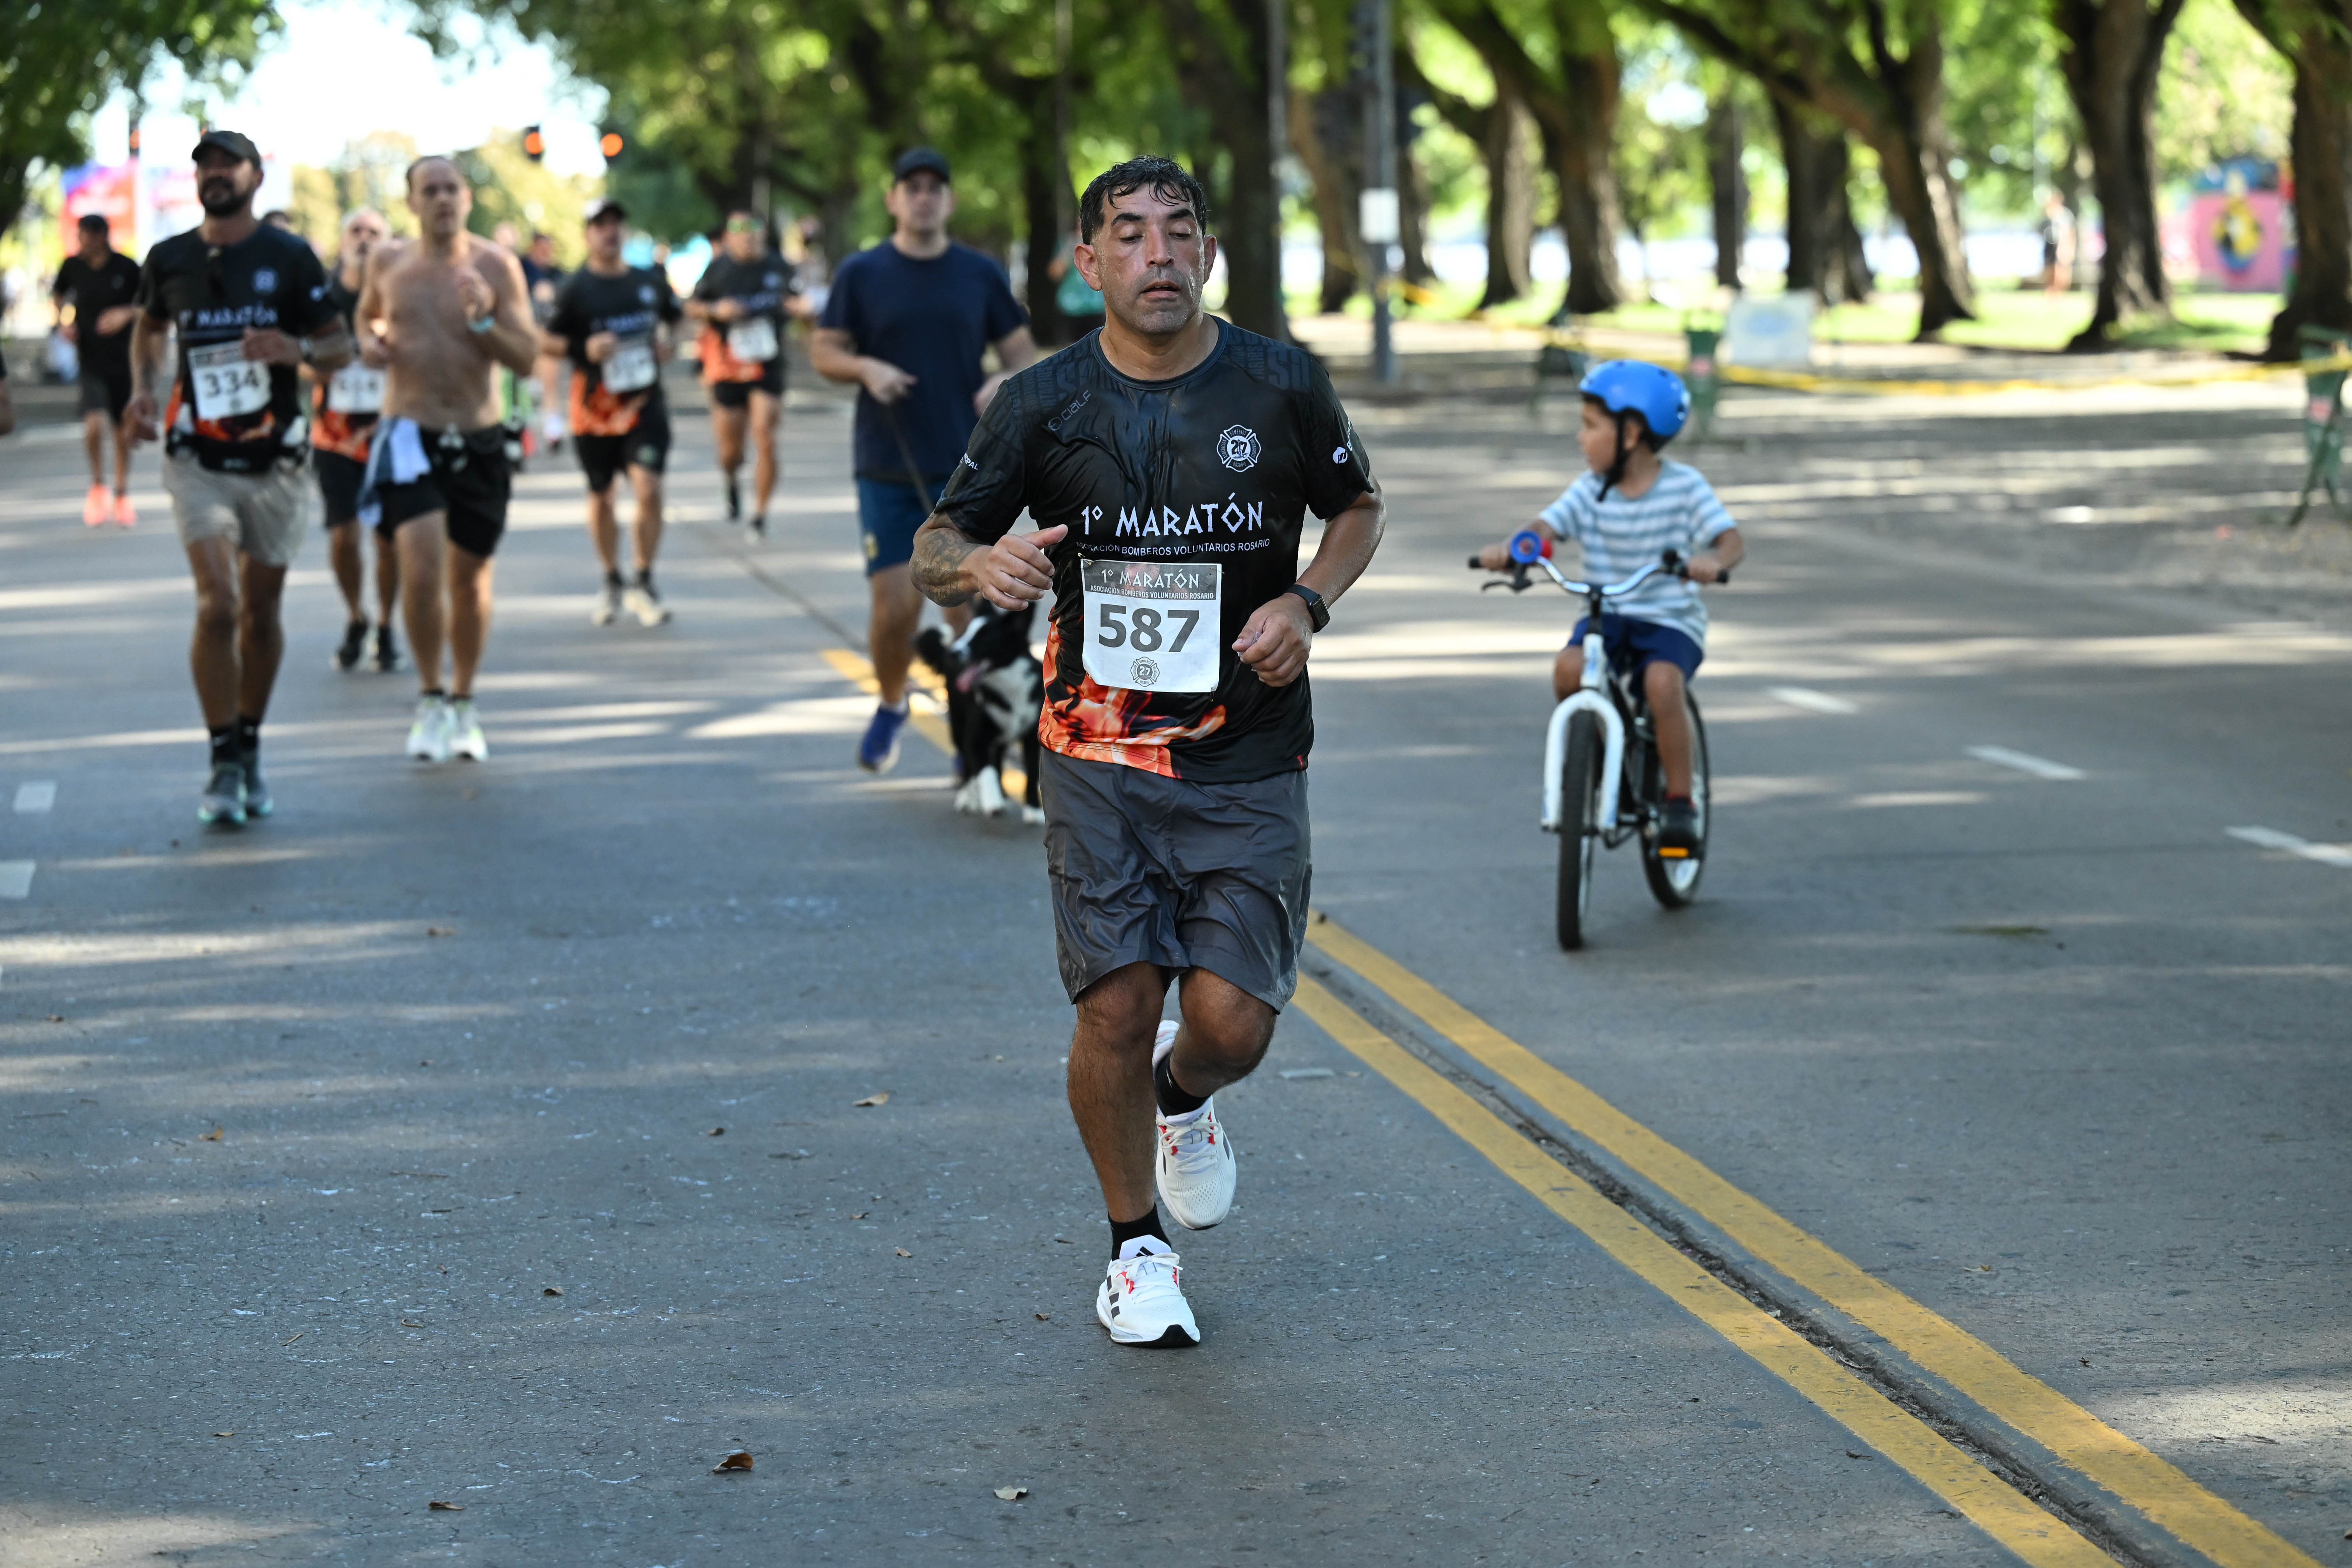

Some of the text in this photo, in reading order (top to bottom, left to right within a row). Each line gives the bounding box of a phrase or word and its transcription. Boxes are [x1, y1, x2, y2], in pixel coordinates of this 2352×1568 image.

[205, 368, 259, 397] 334
[1231, 439, 1247, 455] 27
[1115, 492, 1263, 537] MARATÓN
[1122, 546, 1171, 556] BOMBEROS
[1174, 542, 1236, 555] VOLUNTARIOS
[1238, 538, 1270, 551] ROSARIO
[1119, 568, 1199, 589] MARATÓN
[1090, 584, 1120, 594] ASOCIACIÓN
[1121, 589, 1149, 598] BOMBEROS
[1099, 603, 1200, 653] 587
[1139, 665, 1151, 676] 27
